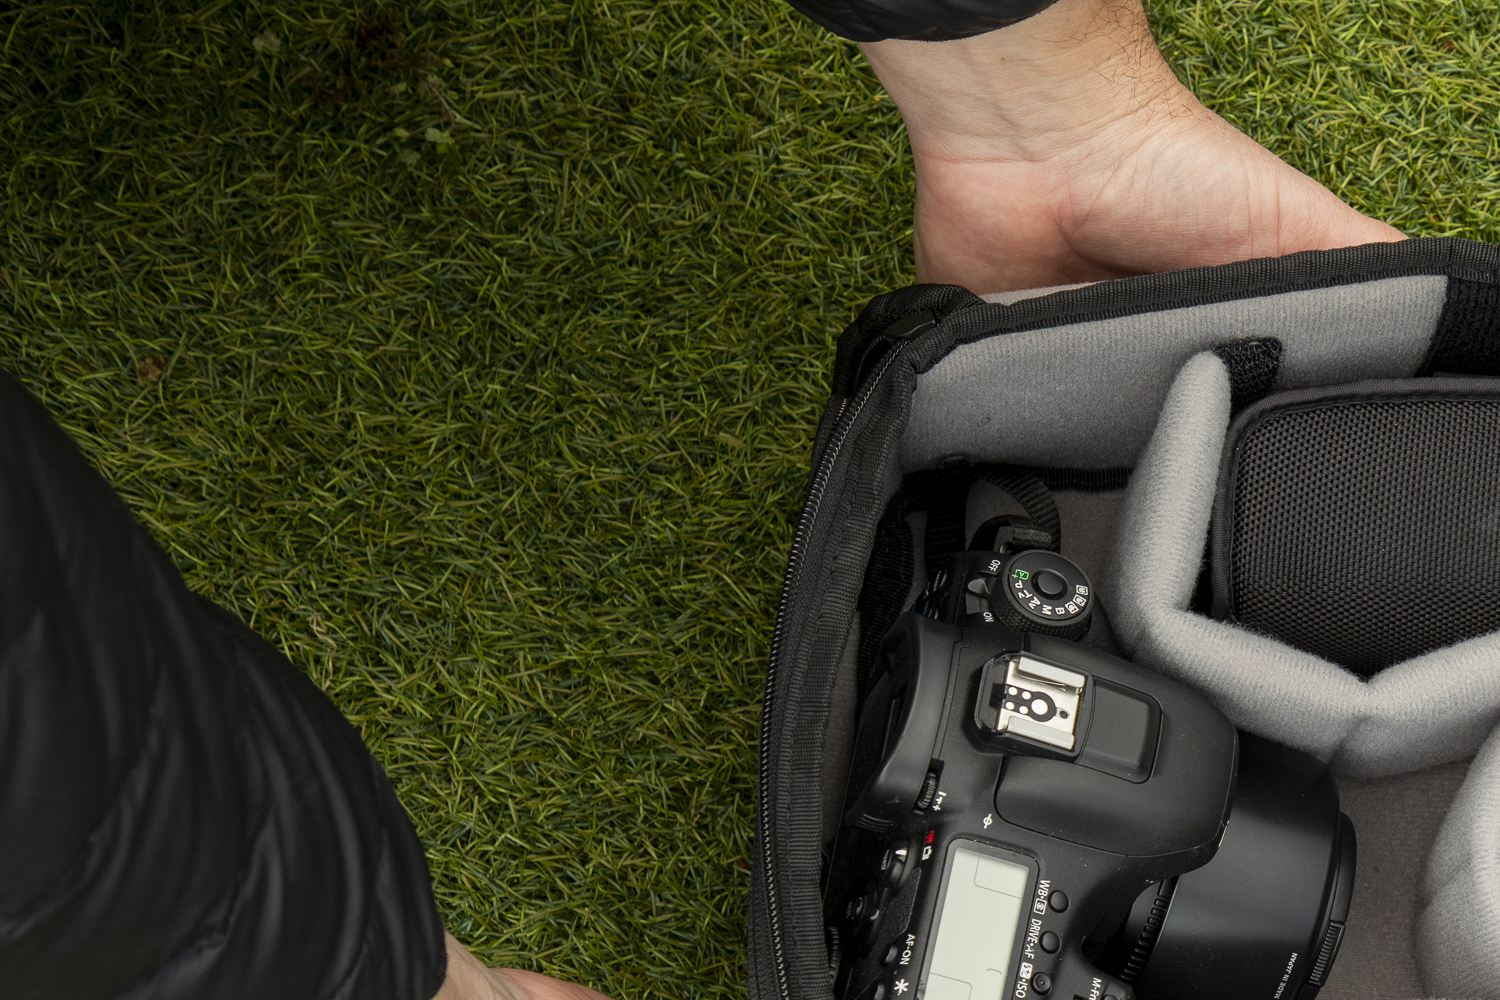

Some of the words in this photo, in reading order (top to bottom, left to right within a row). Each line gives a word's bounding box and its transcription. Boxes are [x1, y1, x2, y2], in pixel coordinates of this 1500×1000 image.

[988, 560, 1000, 572] OFF
[1015, 580, 1023, 589] P
[1018, 589, 1032, 599] Tv
[1028, 596, 1041, 609] Av
[1042, 604, 1052, 615] M
[1055, 607, 1065, 615] B
[983, 612, 994, 622] ON
[1274, 982, 1286, 999] MADE
[1286, 953, 1298, 973] JAPAN
[1089, 977, 1101, 1000] M-Fn
